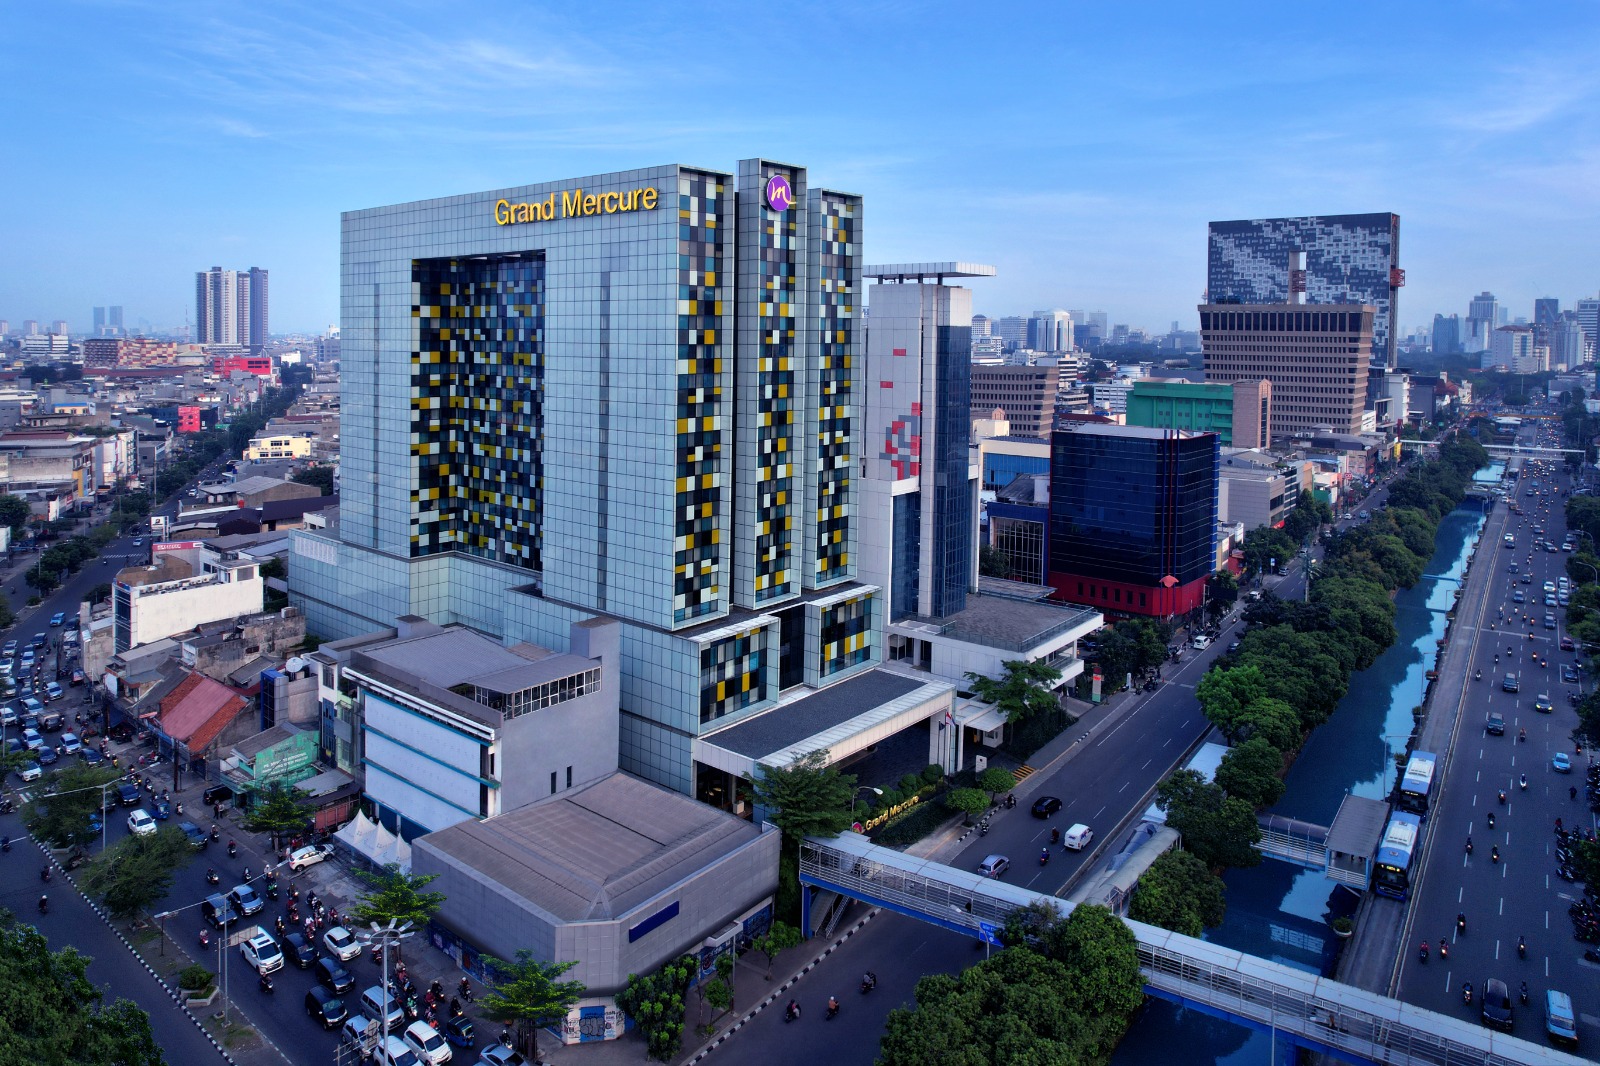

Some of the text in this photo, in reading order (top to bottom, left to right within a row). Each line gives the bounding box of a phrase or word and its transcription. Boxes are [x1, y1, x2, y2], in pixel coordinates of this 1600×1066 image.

[494, 186, 658, 225] Grand Mercure
[866, 795, 919, 830] Grand Mercure
